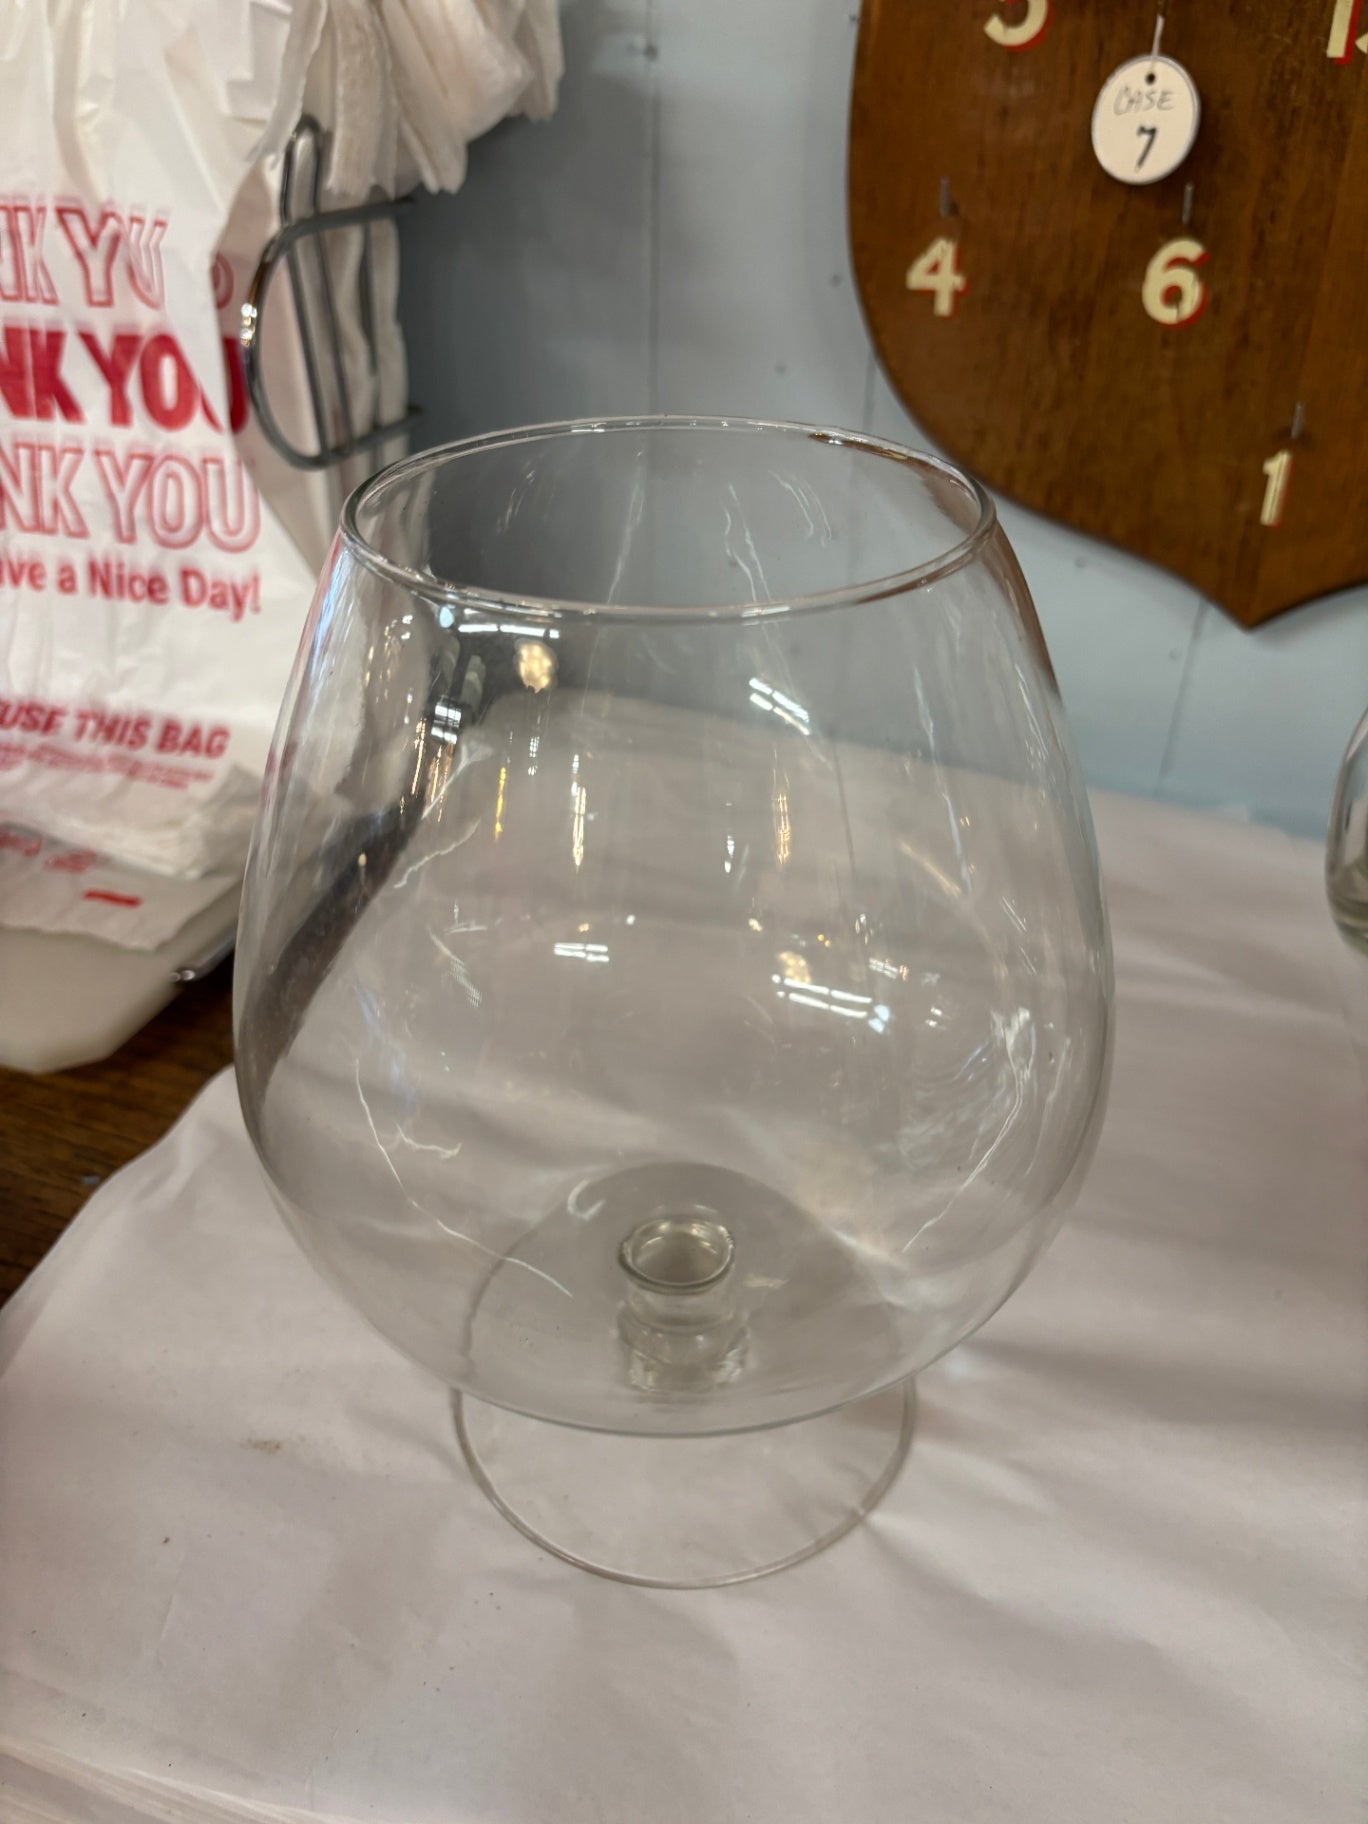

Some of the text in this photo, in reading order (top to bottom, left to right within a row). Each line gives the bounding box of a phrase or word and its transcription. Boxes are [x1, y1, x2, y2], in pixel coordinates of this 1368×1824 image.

[1326, 0, 1368, 60] 1
[1135, 124, 1157, 172] 7
[906, 238, 968, 317] 4
[1142, 238, 1206, 326] 6
[94, 448, 261, 554] YOU
[1261, 449, 1293, 526] 1
[0, 558, 261, 622] ve a Nice Day!
[74, 708, 151, 751] THIS
[155, 717, 230, 760] BAG
